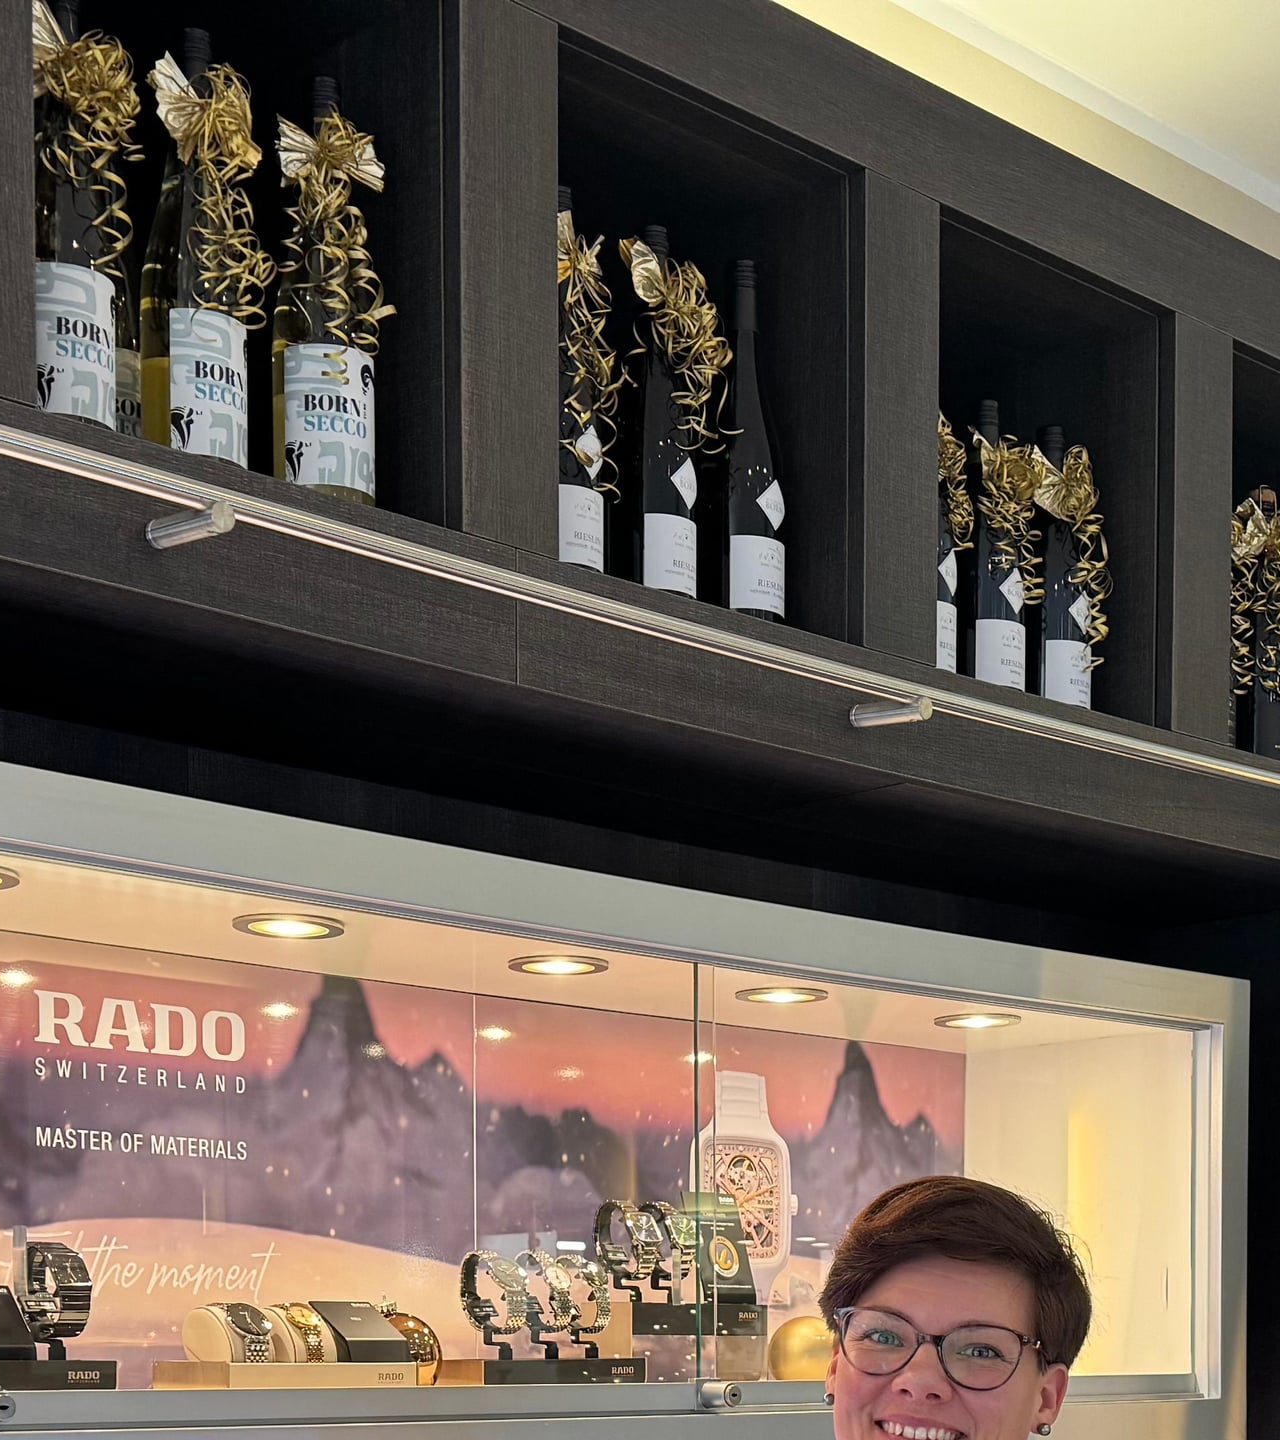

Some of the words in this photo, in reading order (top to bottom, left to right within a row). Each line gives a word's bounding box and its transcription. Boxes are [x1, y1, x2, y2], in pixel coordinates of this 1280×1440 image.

[56, 316, 111, 350] BORN
[56, 338, 115, 373] SECCO
[195, 360, 244, 392] BORN
[195, 383, 247, 415] SECCO
[304, 394, 362, 417] BORN
[304, 415, 368, 439] SECCO
[33, 989, 245, 1062] RADO
[34, 1057, 246, 1094] SWITZERLAND
[35, 1127, 113, 1151] MASTER
[120, 1132, 144, 1153] OF
[150, 1135, 248, 1160] MATERIALS
[82, 1235, 144, 1297] the
[146, 1241, 282, 1303] moment
[67, 1371, 101, 1380] RADO
[378, 1373, 404, 1381] RADO
[611, 1366, 635, 1375] RADO
